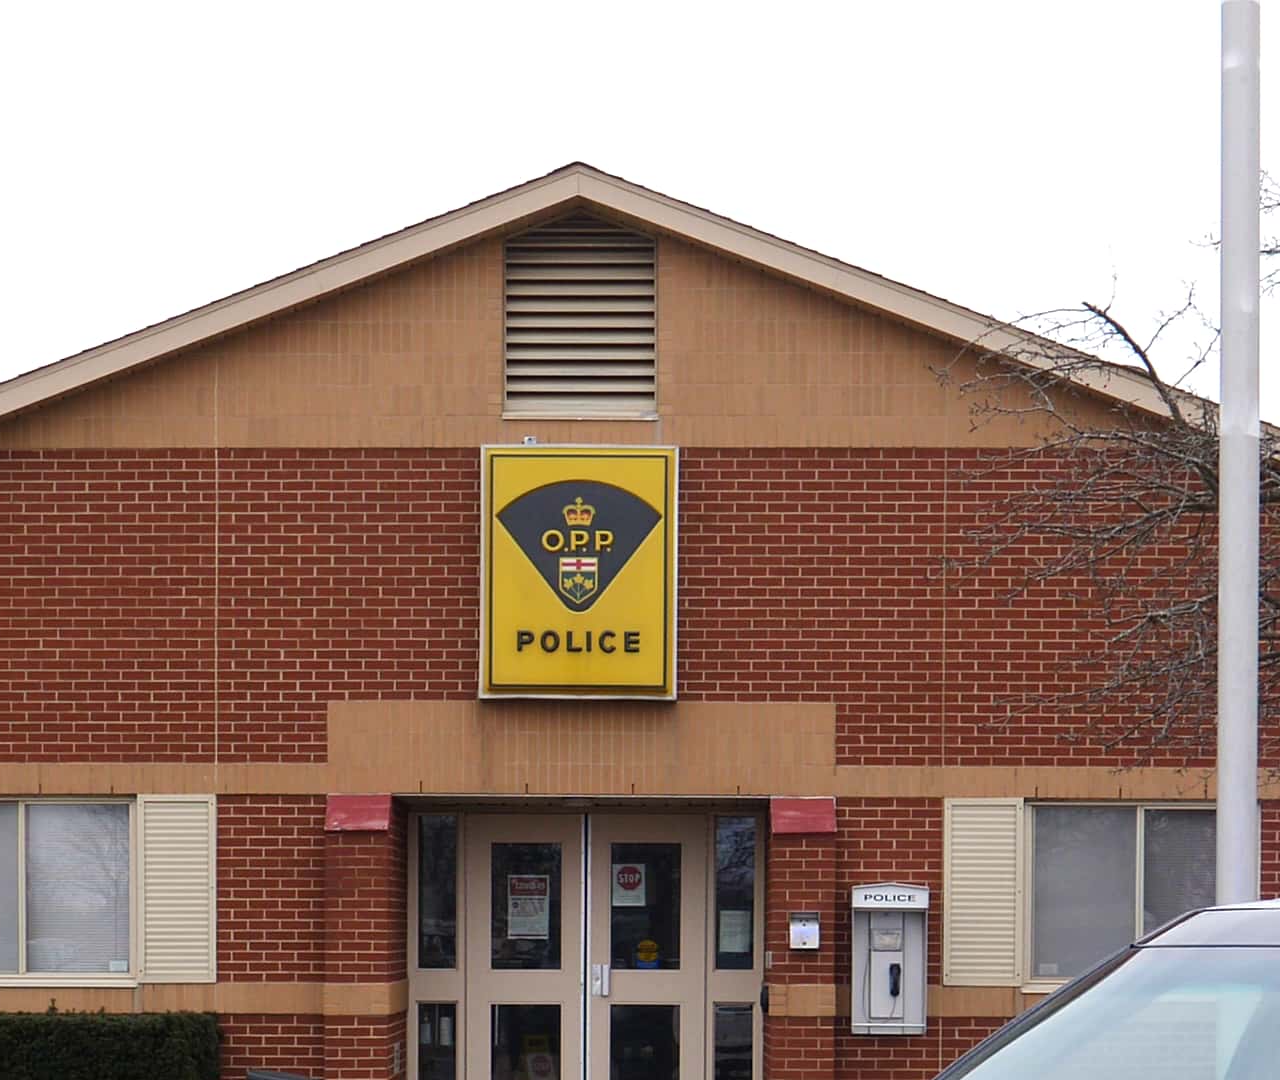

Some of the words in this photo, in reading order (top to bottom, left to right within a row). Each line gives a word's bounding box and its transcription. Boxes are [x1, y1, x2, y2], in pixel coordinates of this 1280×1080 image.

[541, 530, 615, 553] O.P.P.
[516, 630, 641, 654] POLICE
[618, 873, 641, 883] STOP
[863, 894, 918, 903] POLICE
